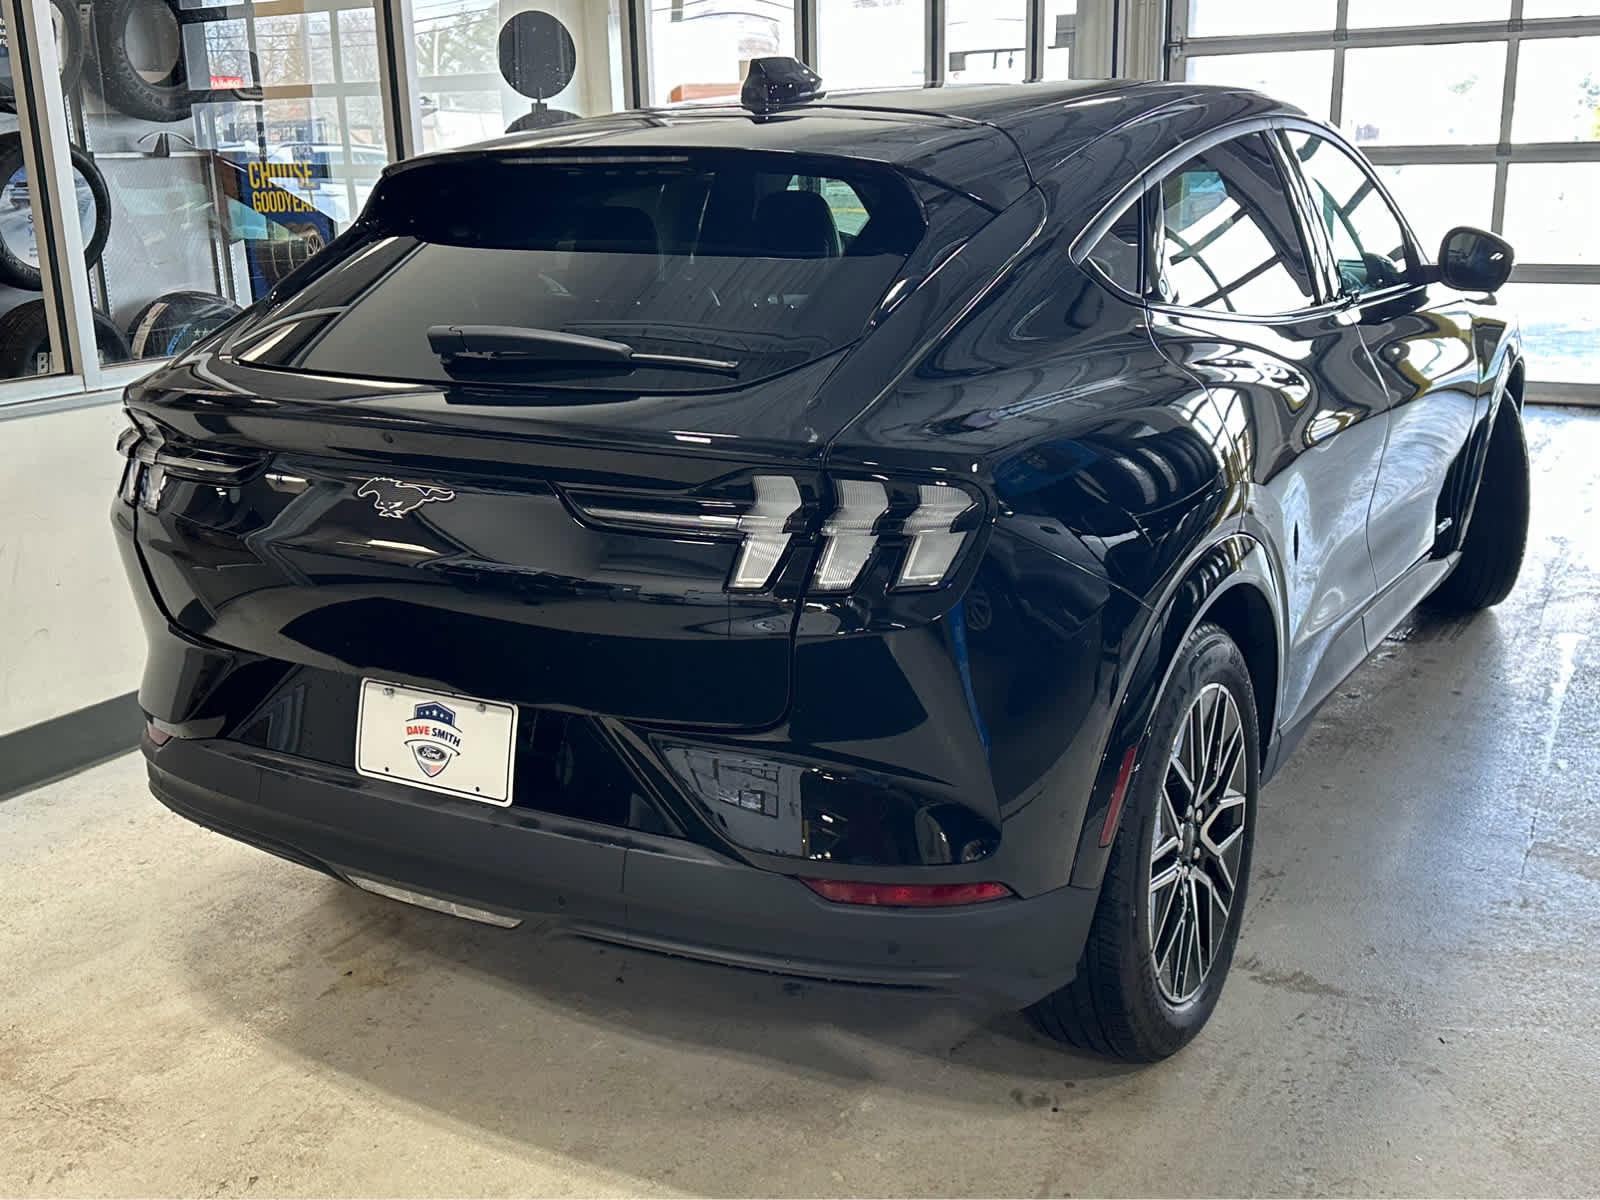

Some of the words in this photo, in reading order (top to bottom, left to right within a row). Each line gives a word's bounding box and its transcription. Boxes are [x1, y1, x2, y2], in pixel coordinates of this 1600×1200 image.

[248, 160, 315, 189] CHOOSE
[406, 725, 430, 736] DAVE
[432, 727, 461, 747] SMITH
